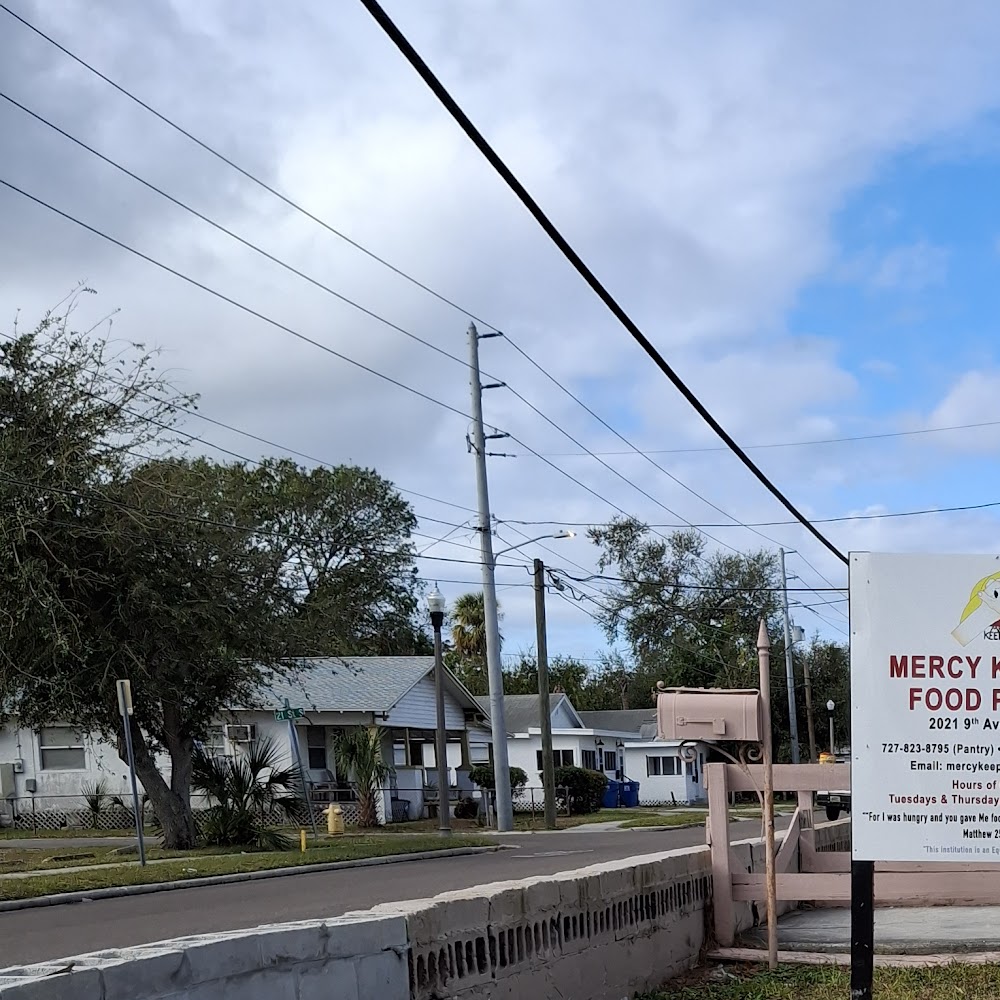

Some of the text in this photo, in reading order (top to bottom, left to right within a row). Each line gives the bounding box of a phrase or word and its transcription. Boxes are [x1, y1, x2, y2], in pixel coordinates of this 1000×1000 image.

[890, 655, 982, 679] MERCY
[910, 688, 981, 711] FOOD
[929, 717, 957, 729] 2021
[882, 743, 949, 753] 727-823-8795
[953, 744, 994, 756] (Pantry)
[911, 761, 942, 770] Email:
[953, 780, 982, 789] Hours
[987, 780, 997, 789] of
[889, 794, 937, 806] Tuesdays
[941, 794, 947, 804] &
[903, 812, 928, 824] hungry
[930, 812, 943, 822] and
[945, 815, 957, 824] you
[960, 815, 976, 824] gave
[979, 813, 988, 822] Me
[963, 829, 992, 838] Matthew
